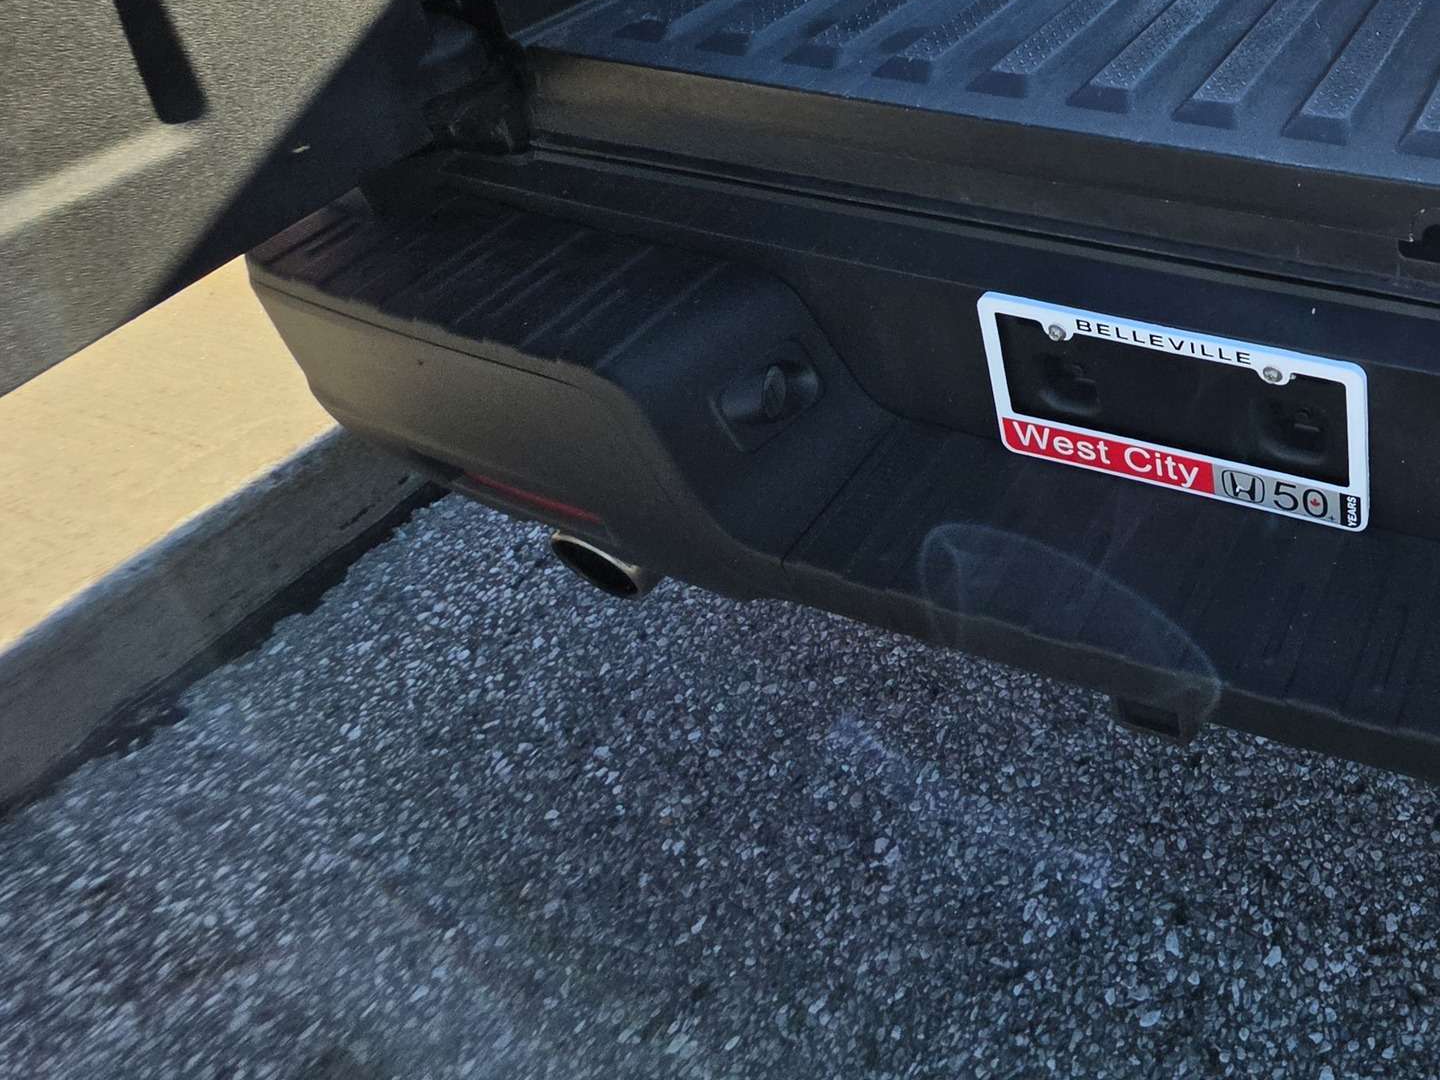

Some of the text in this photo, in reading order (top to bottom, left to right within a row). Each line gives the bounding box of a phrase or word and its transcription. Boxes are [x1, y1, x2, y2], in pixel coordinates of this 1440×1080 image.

[1075, 319, 1251, 365] BELLEVILLE
[1012, 421, 1110, 465] West
[1123, 447, 1200, 488] City
[1273, 481, 1328, 518] 50
[1347, 496, 1358, 527] YEARS
